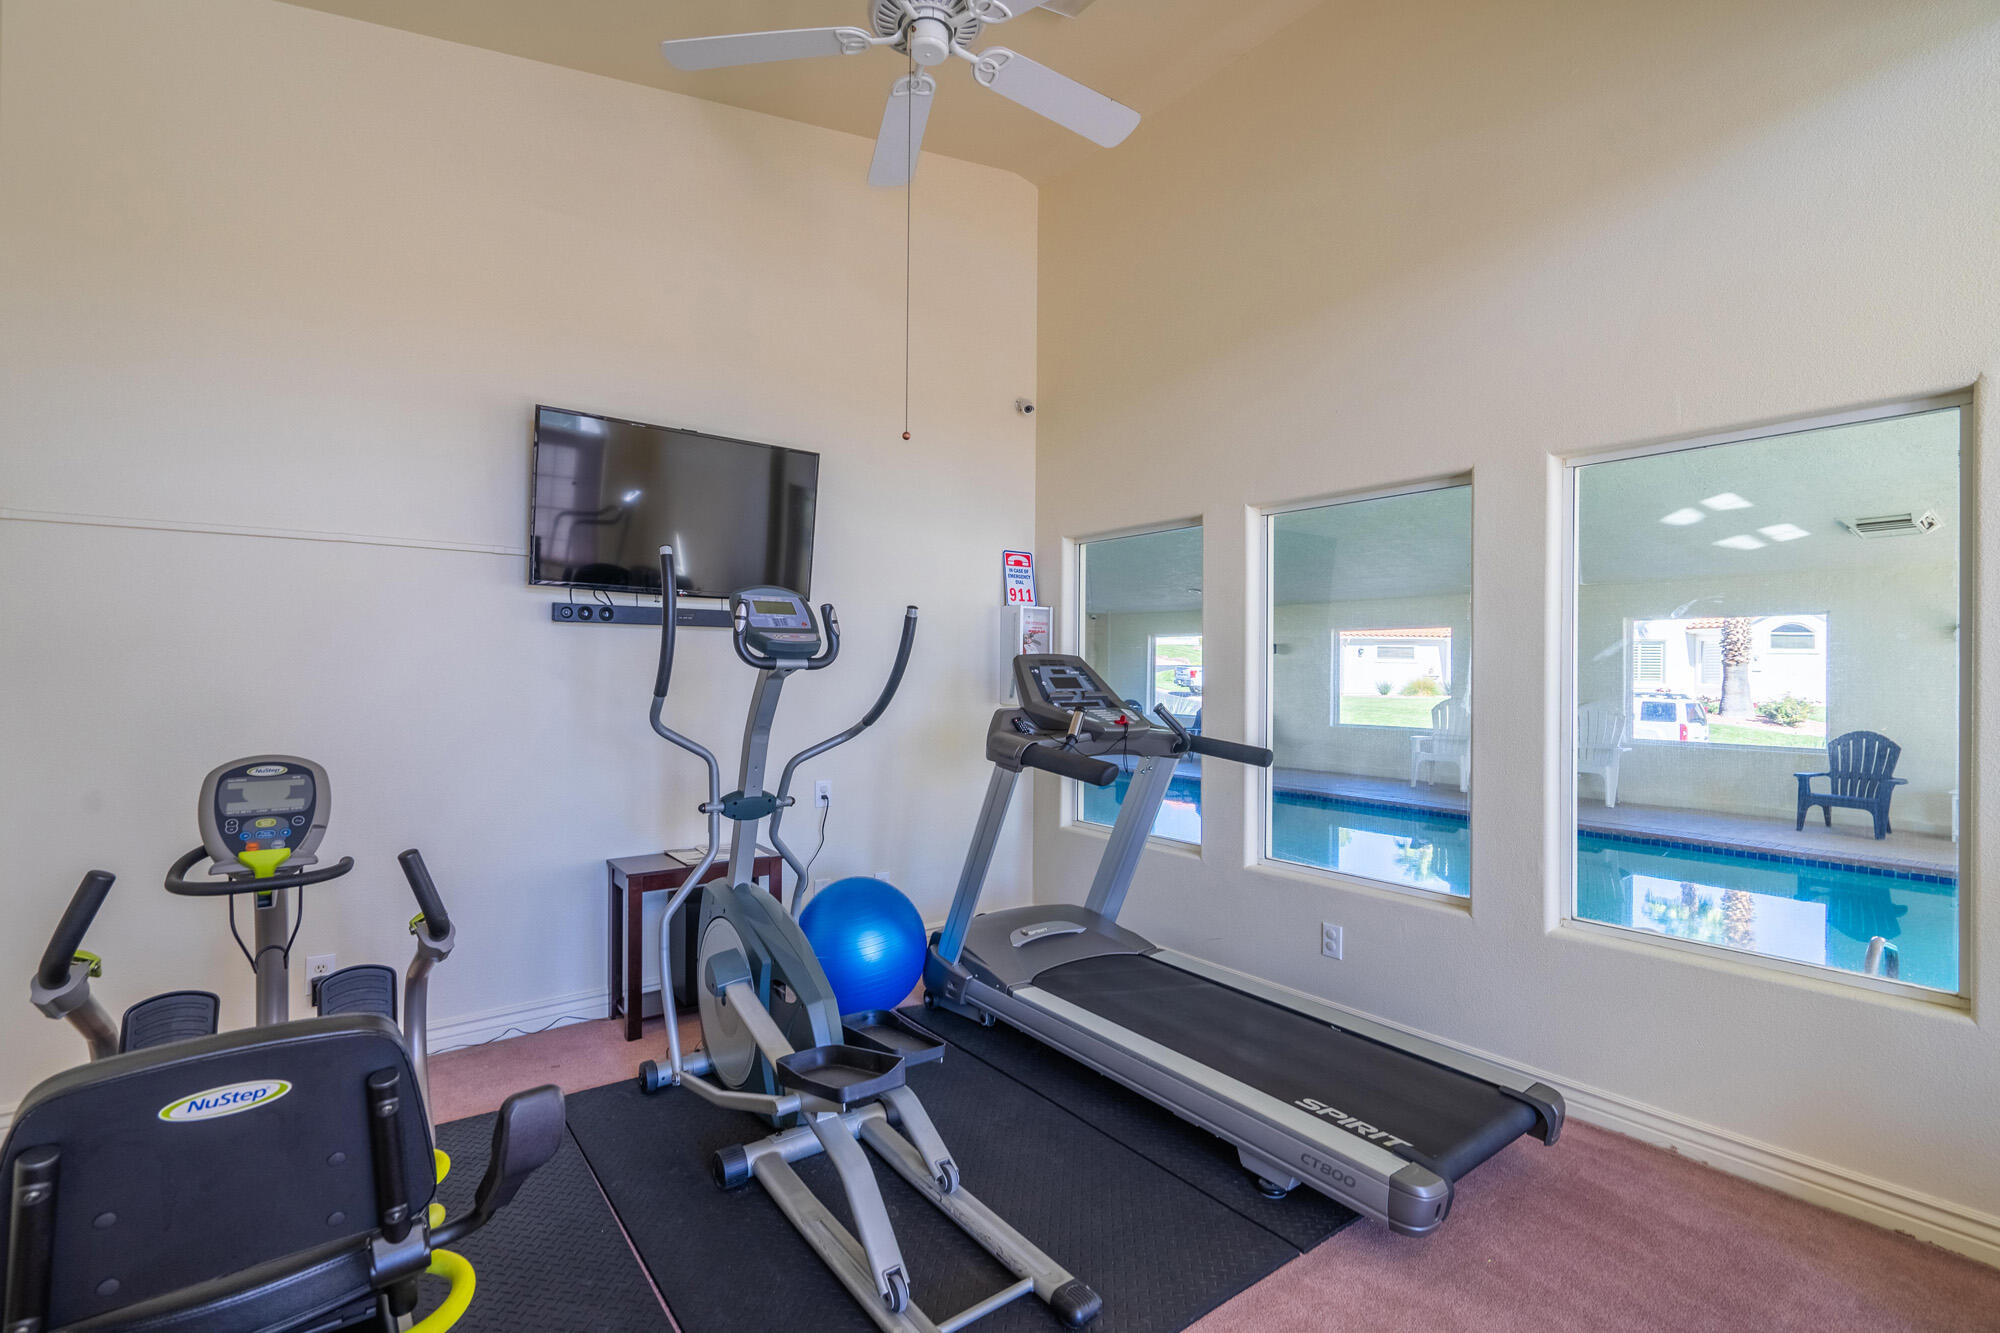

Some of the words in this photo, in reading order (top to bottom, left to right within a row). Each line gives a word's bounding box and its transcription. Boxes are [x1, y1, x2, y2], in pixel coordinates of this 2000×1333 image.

[1009, 588, 1033, 602] 911
[187, 1088, 267, 1113] NuStep
[1294, 1098, 1414, 1147] SPIRIT
[1301, 1153, 1356, 1188] CT800
